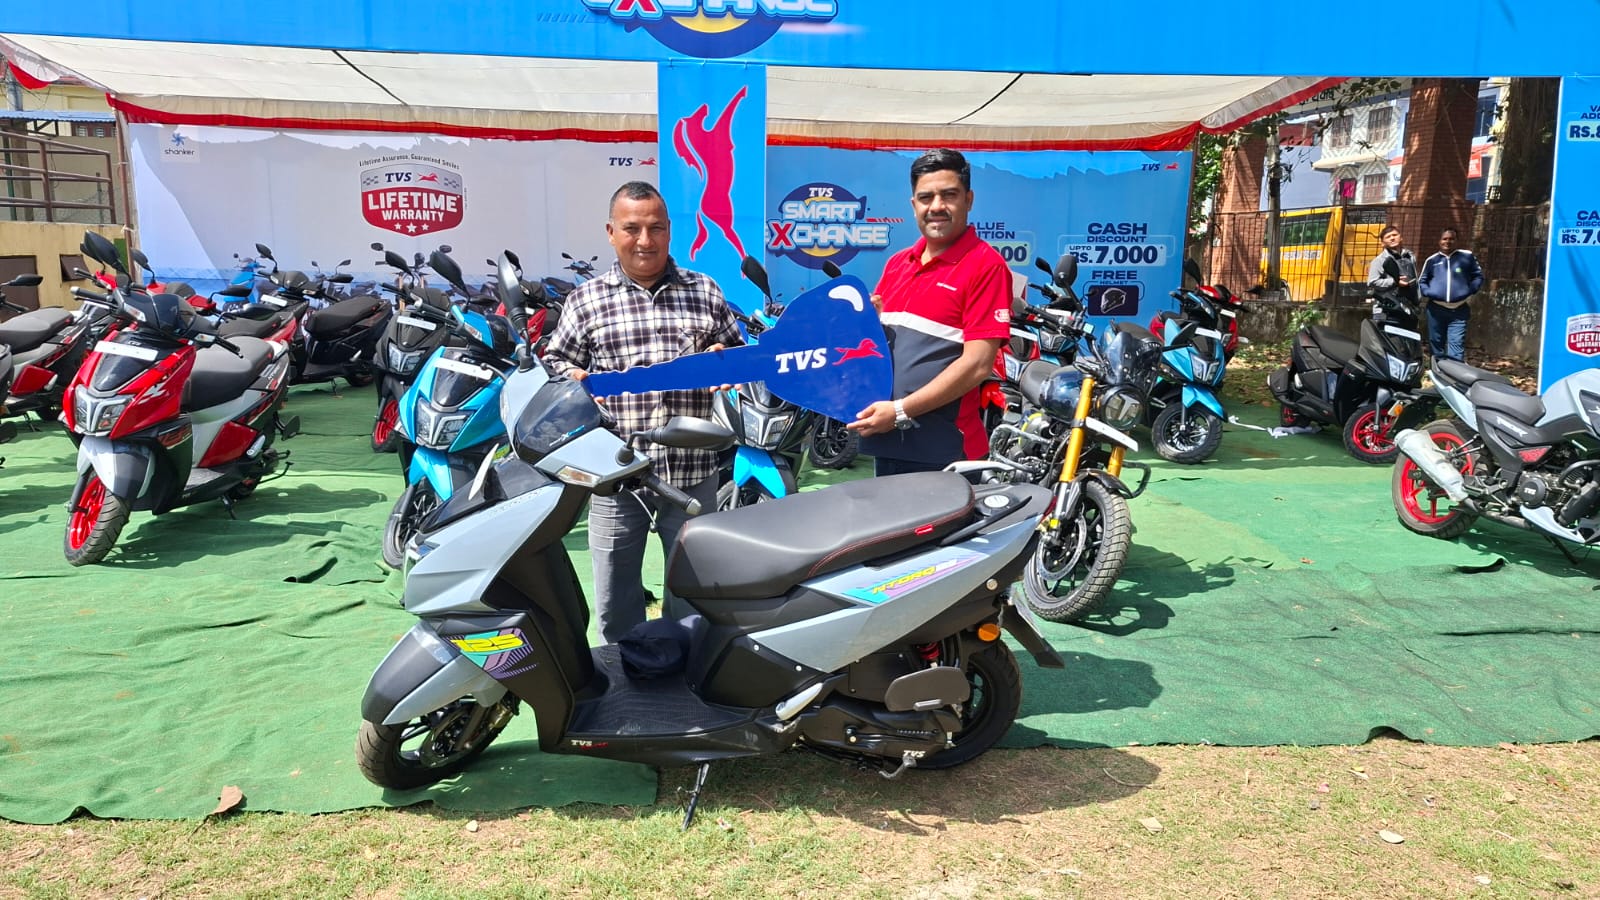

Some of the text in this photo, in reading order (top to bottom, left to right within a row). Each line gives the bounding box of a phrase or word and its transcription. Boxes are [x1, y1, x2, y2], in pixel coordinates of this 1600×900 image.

[608, 157, 633, 166] TVS
[1142, 163, 1160, 171] TVS
[385, 172, 412, 182] TVS
[809, 187, 833, 197] TVS
[368, 191, 458, 213] LIFETIME
[382, 209, 445, 222] WARRANTY
[785, 203, 859, 220] SMART
[1088, 222, 1147, 235] CASH
[1087, 235, 1147, 243] DISCOUNT
[1092, 270, 1137, 280] FREE
[1570, 332, 1600, 344] LIFETI
[776, 348, 827, 374] TVS
[450, 633, 524, 653] 125
[903, 750, 927, 758] TVS
